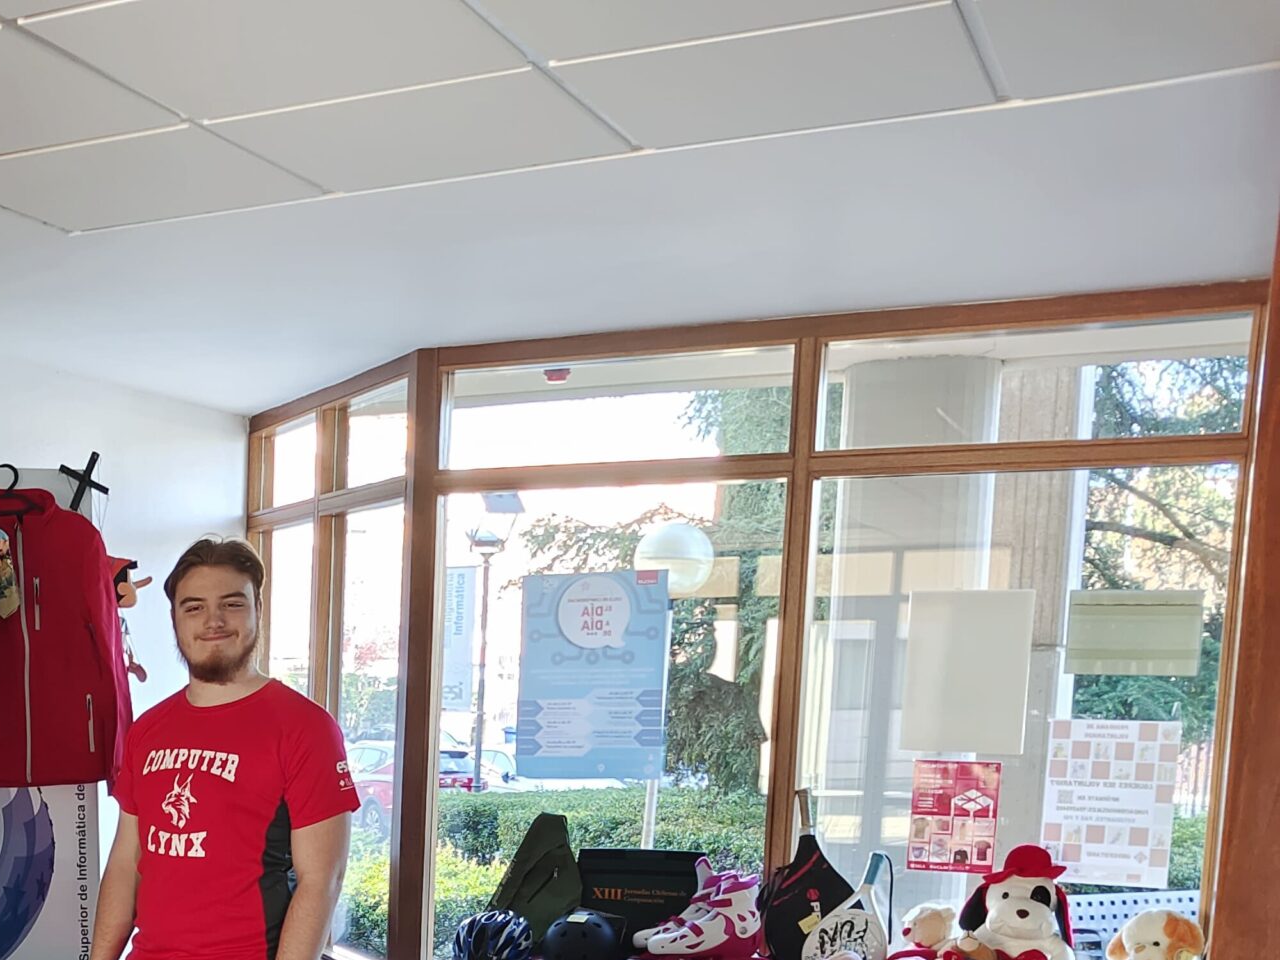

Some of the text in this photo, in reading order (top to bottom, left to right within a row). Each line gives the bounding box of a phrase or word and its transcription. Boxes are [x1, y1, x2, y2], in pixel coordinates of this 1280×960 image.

[454, 573, 465, 636] Informática
[143, 749, 240, 783] COMPUTER
[74, 784, 85, 801] de
[75, 804, 87, 881] Informática
[147, 826, 207, 858] LYNX
[77, 885, 88, 901] de
[592, 888, 623, 900] XIII
